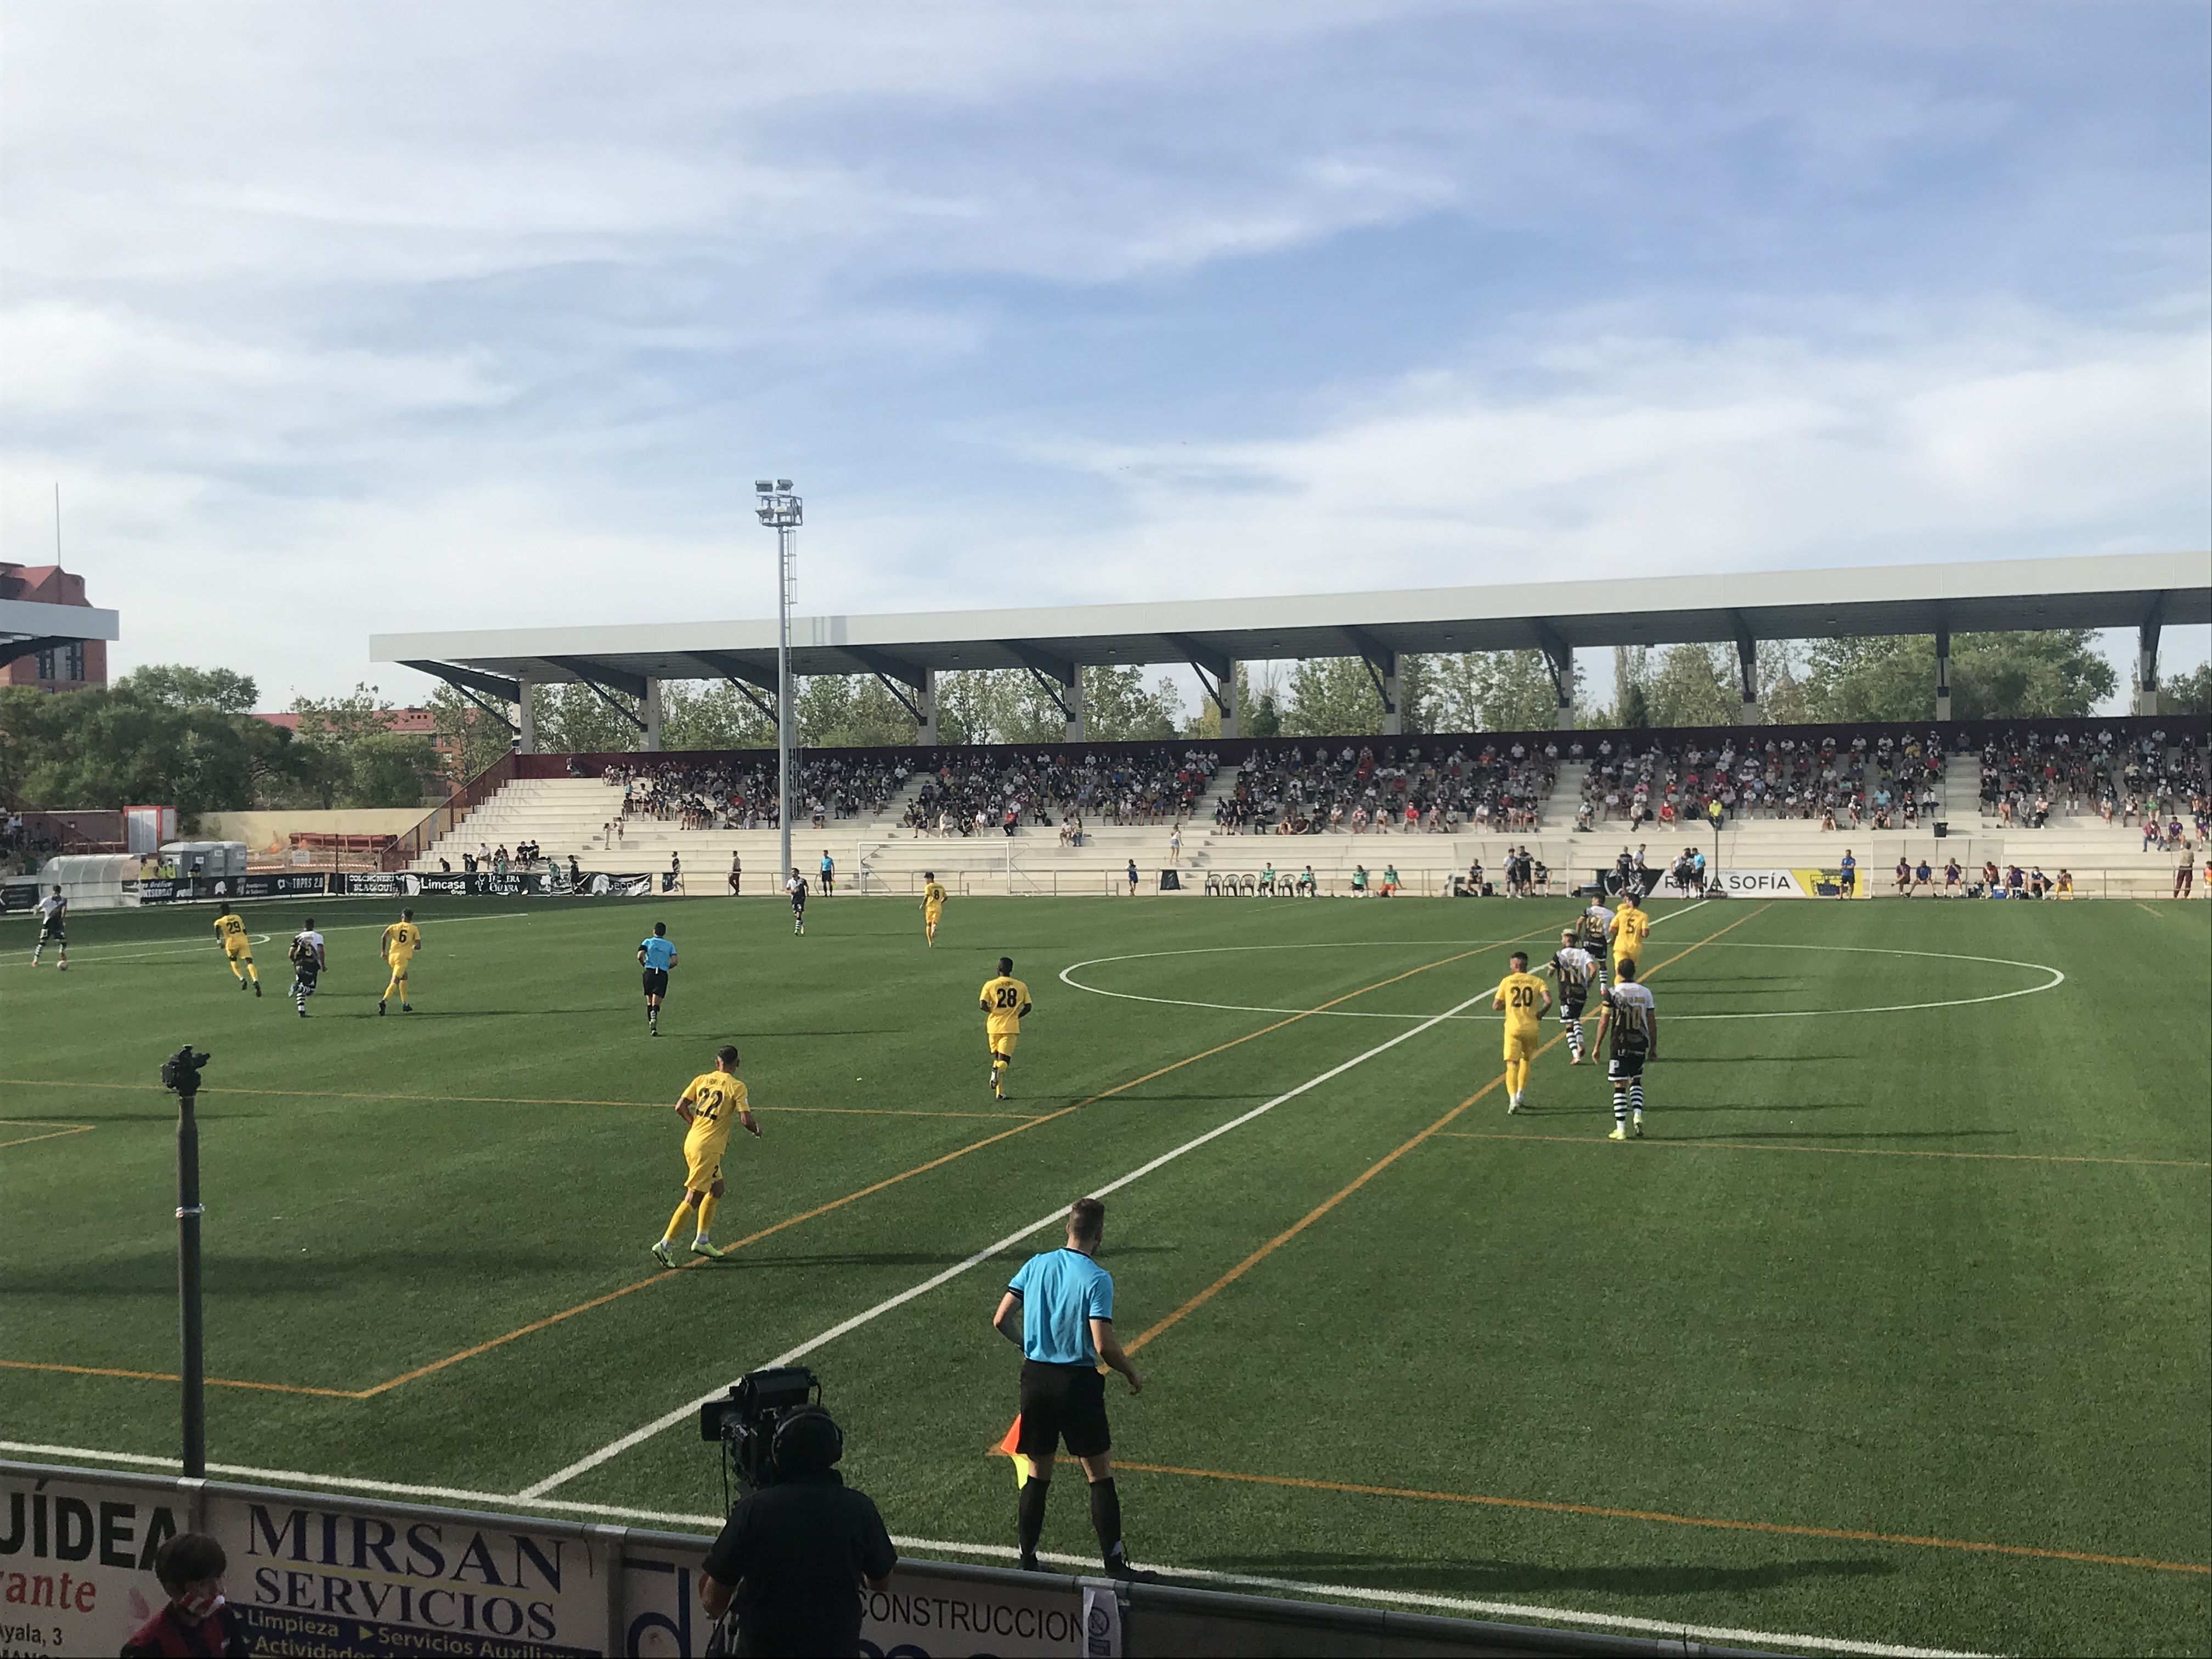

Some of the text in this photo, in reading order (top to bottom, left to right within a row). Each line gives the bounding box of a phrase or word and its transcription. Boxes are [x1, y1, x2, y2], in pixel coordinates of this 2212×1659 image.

[421, 877, 466, 889] Limcasa
[1730, 873, 1791, 889] SOFÍA
[934, 889, 940, 900] 8
[226, 921, 241, 934] 29
[399, 929, 407, 943] 6
[1627, 918, 1635, 934] 5
[997, 988, 1017, 1008] 28
[1511, 986, 1533, 1008] 20
[1623, 1005, 1641, 1030] 10
[696, 1088, 723, 1121] 22
[243, 1503, 567, 1594] MIRSAN
[0, 1571, 97, 1613] ante
[255, 1566, 556, 1641] SERVICIOS
[247, 1611, 340, 1638] Limpieza
[52, 1626, 63, 1646] 3
[378, 1626, 473, 1656] Servicios
